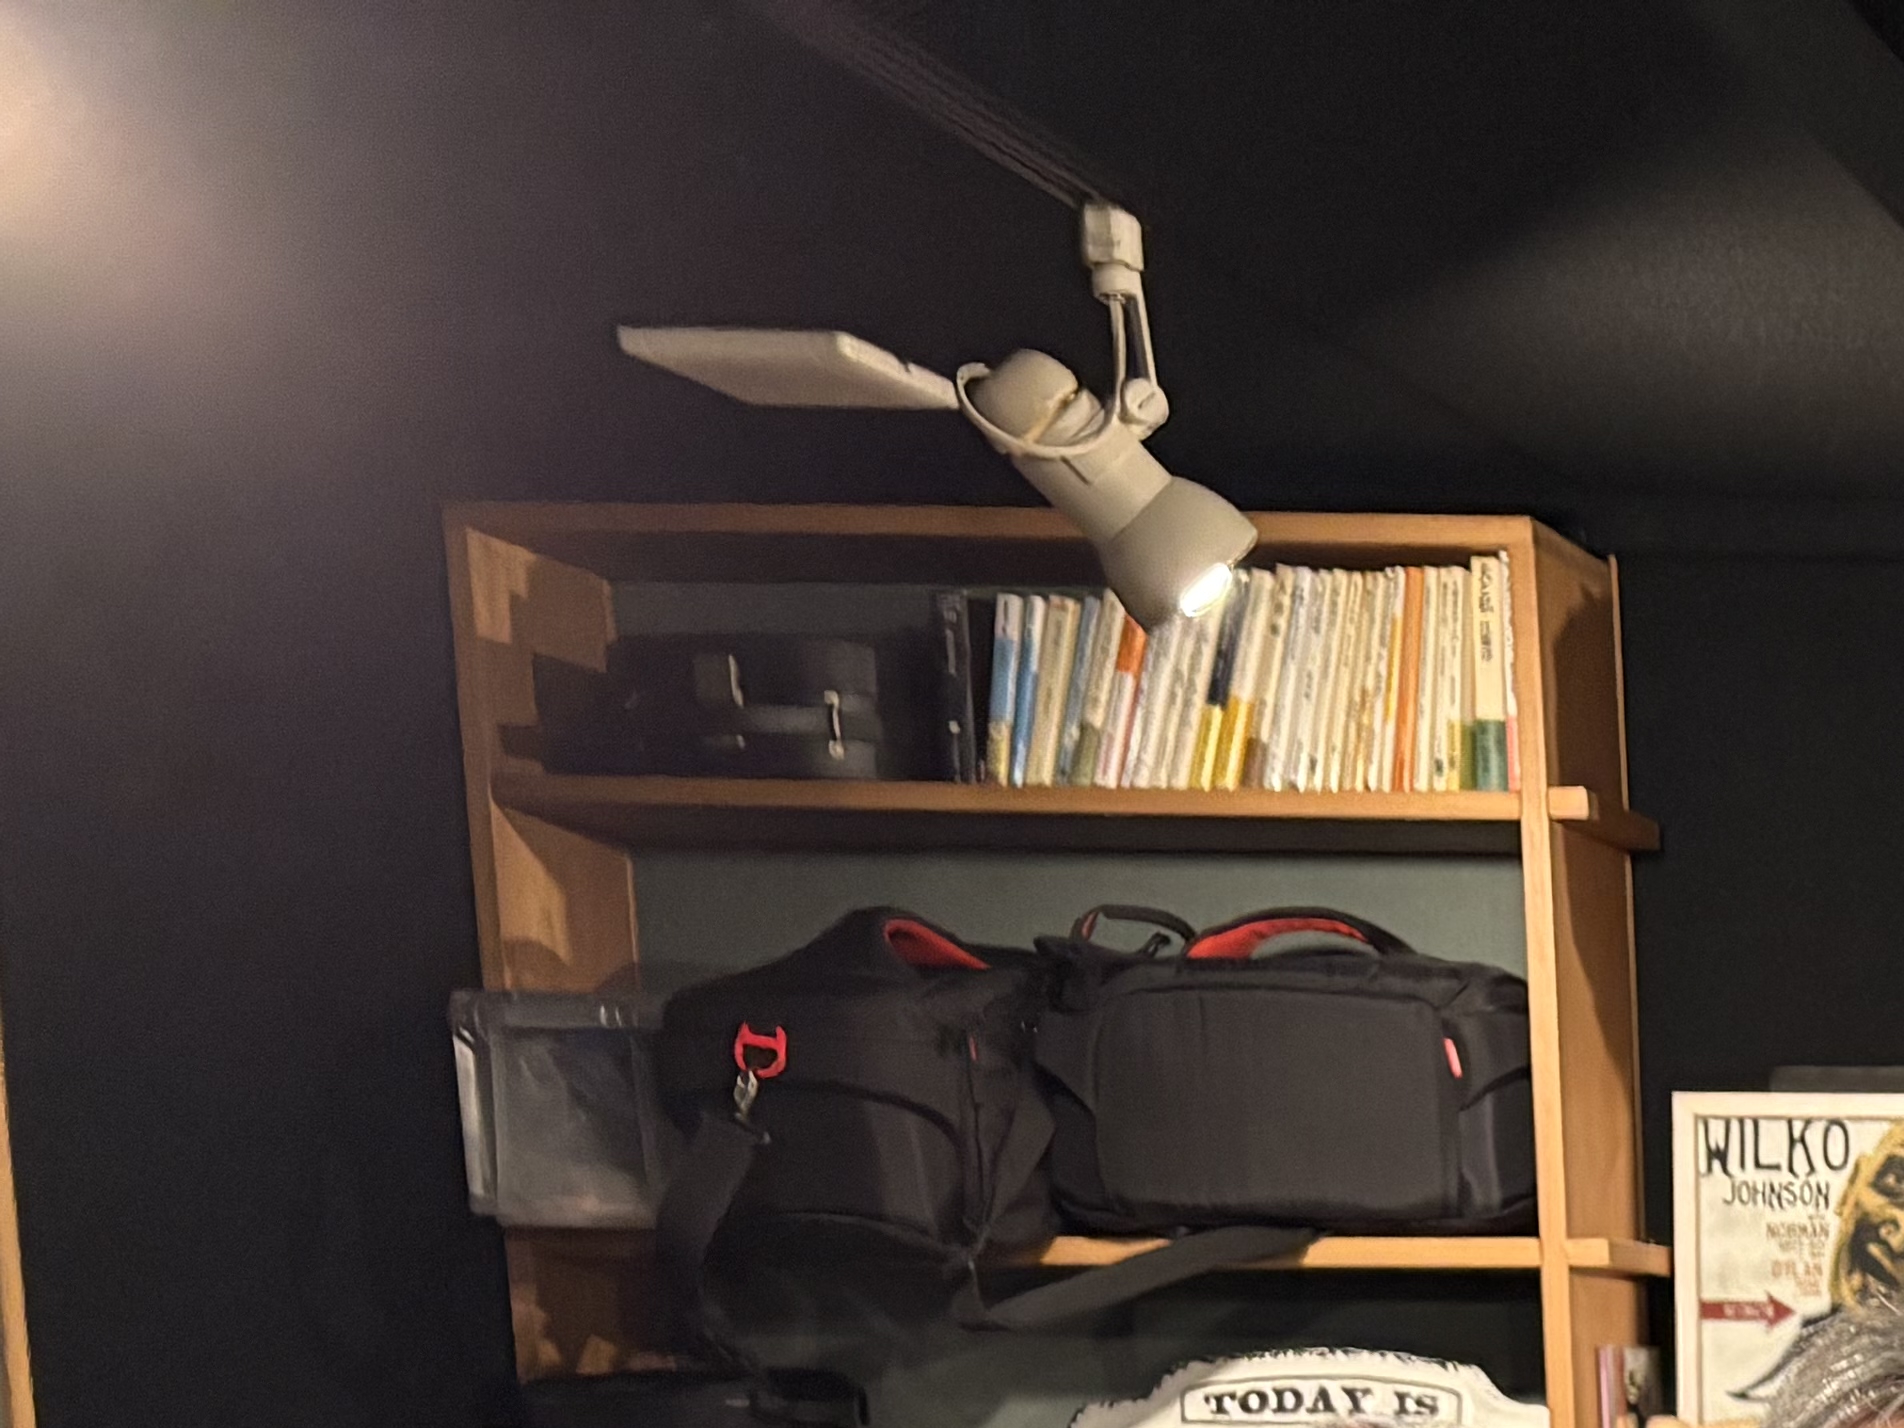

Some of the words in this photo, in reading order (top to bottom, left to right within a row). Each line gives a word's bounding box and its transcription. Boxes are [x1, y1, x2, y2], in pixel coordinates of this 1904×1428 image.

[1700, 1119, 1849, 1178] WILKO
[1722, 1180, 1830, 1211] JOHNSON
[1204, 1387, 1373, 1417] TODAY
[1394, 1389, 1440, 1418] IS
